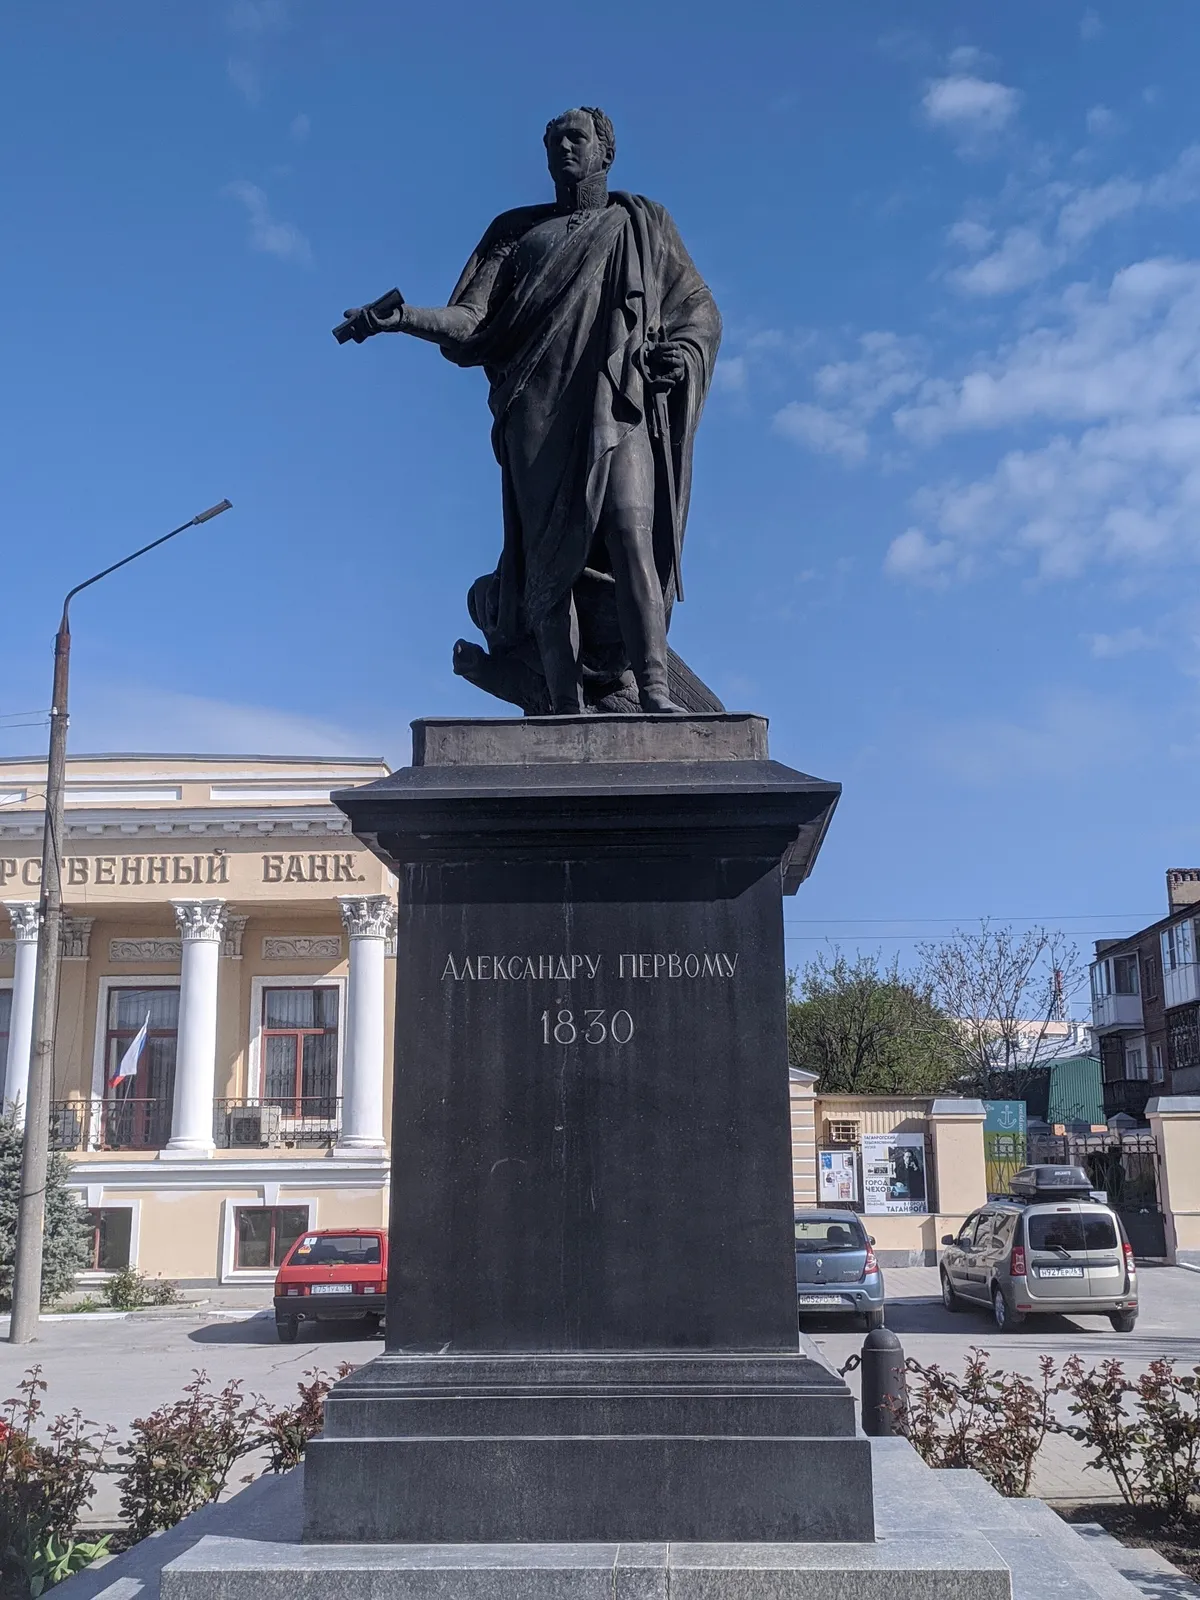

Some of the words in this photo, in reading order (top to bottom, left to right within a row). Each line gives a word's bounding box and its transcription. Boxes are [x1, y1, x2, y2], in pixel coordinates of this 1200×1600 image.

[0, 849, 230, 886] РСВЕННЫЙ
[440, 952, 602, 980] АЛЕКСАНДРУ
[619, 953, 739, 979] ПЕРВОМУ
[541, 1009, 634, 1044] 1830
